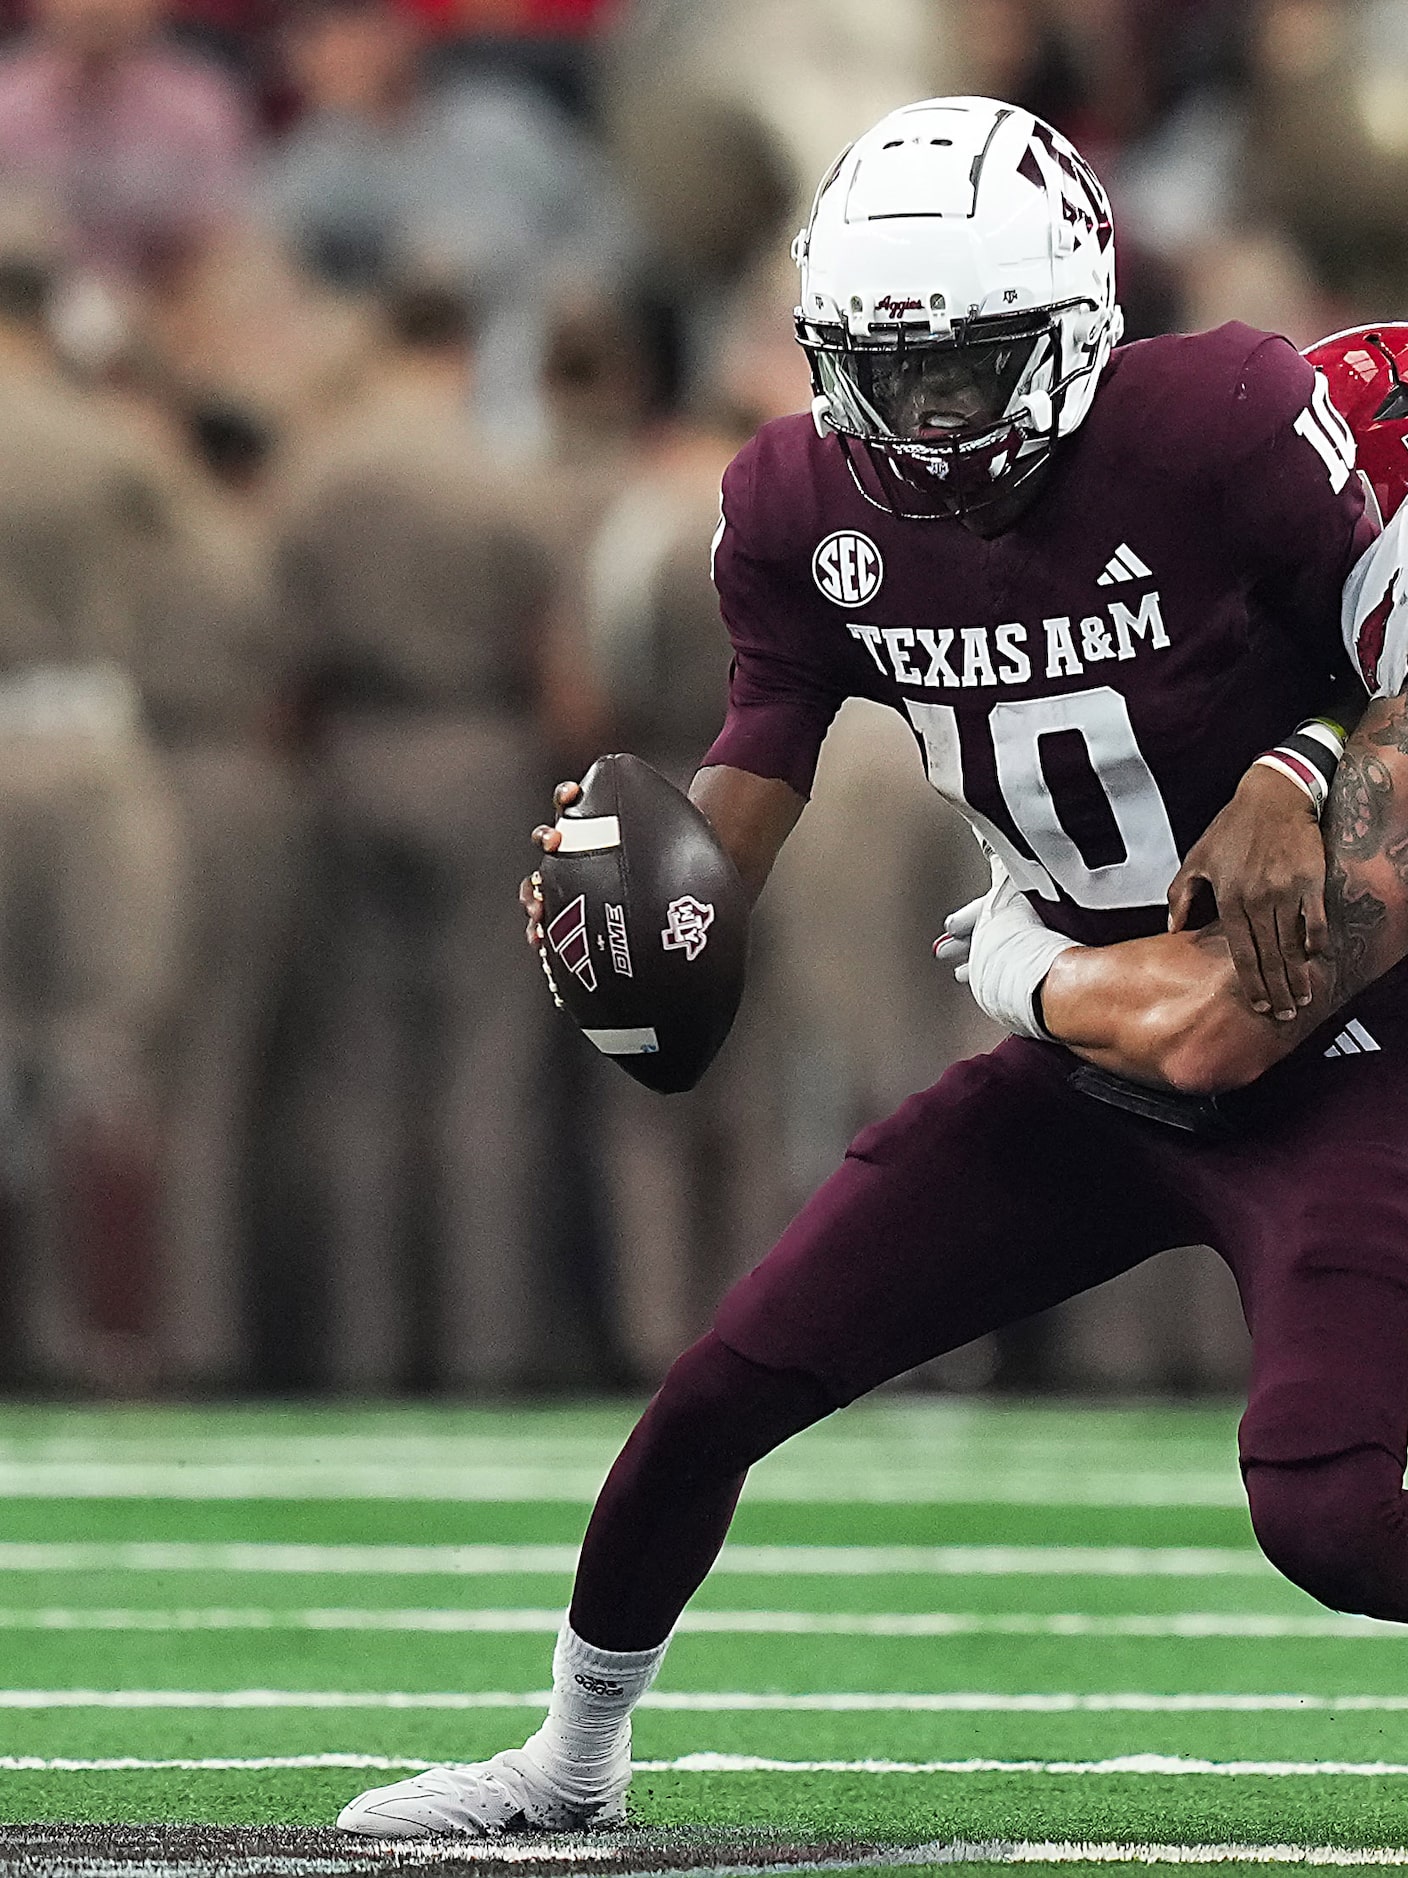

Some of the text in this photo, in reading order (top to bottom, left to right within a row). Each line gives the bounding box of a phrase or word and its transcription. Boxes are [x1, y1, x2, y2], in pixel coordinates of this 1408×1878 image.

[875, 295, 925, 319] Aggies
[1293, 370, 1358, 495] 10
[817, 536, 876, 601] SEC
[846, 591, 1171, 687] TEXAS A&M
[902, 685, 1182, 910] 10
[605, 902, 633, 978] DIME
[574, 1673, 624, 1696] adidas
